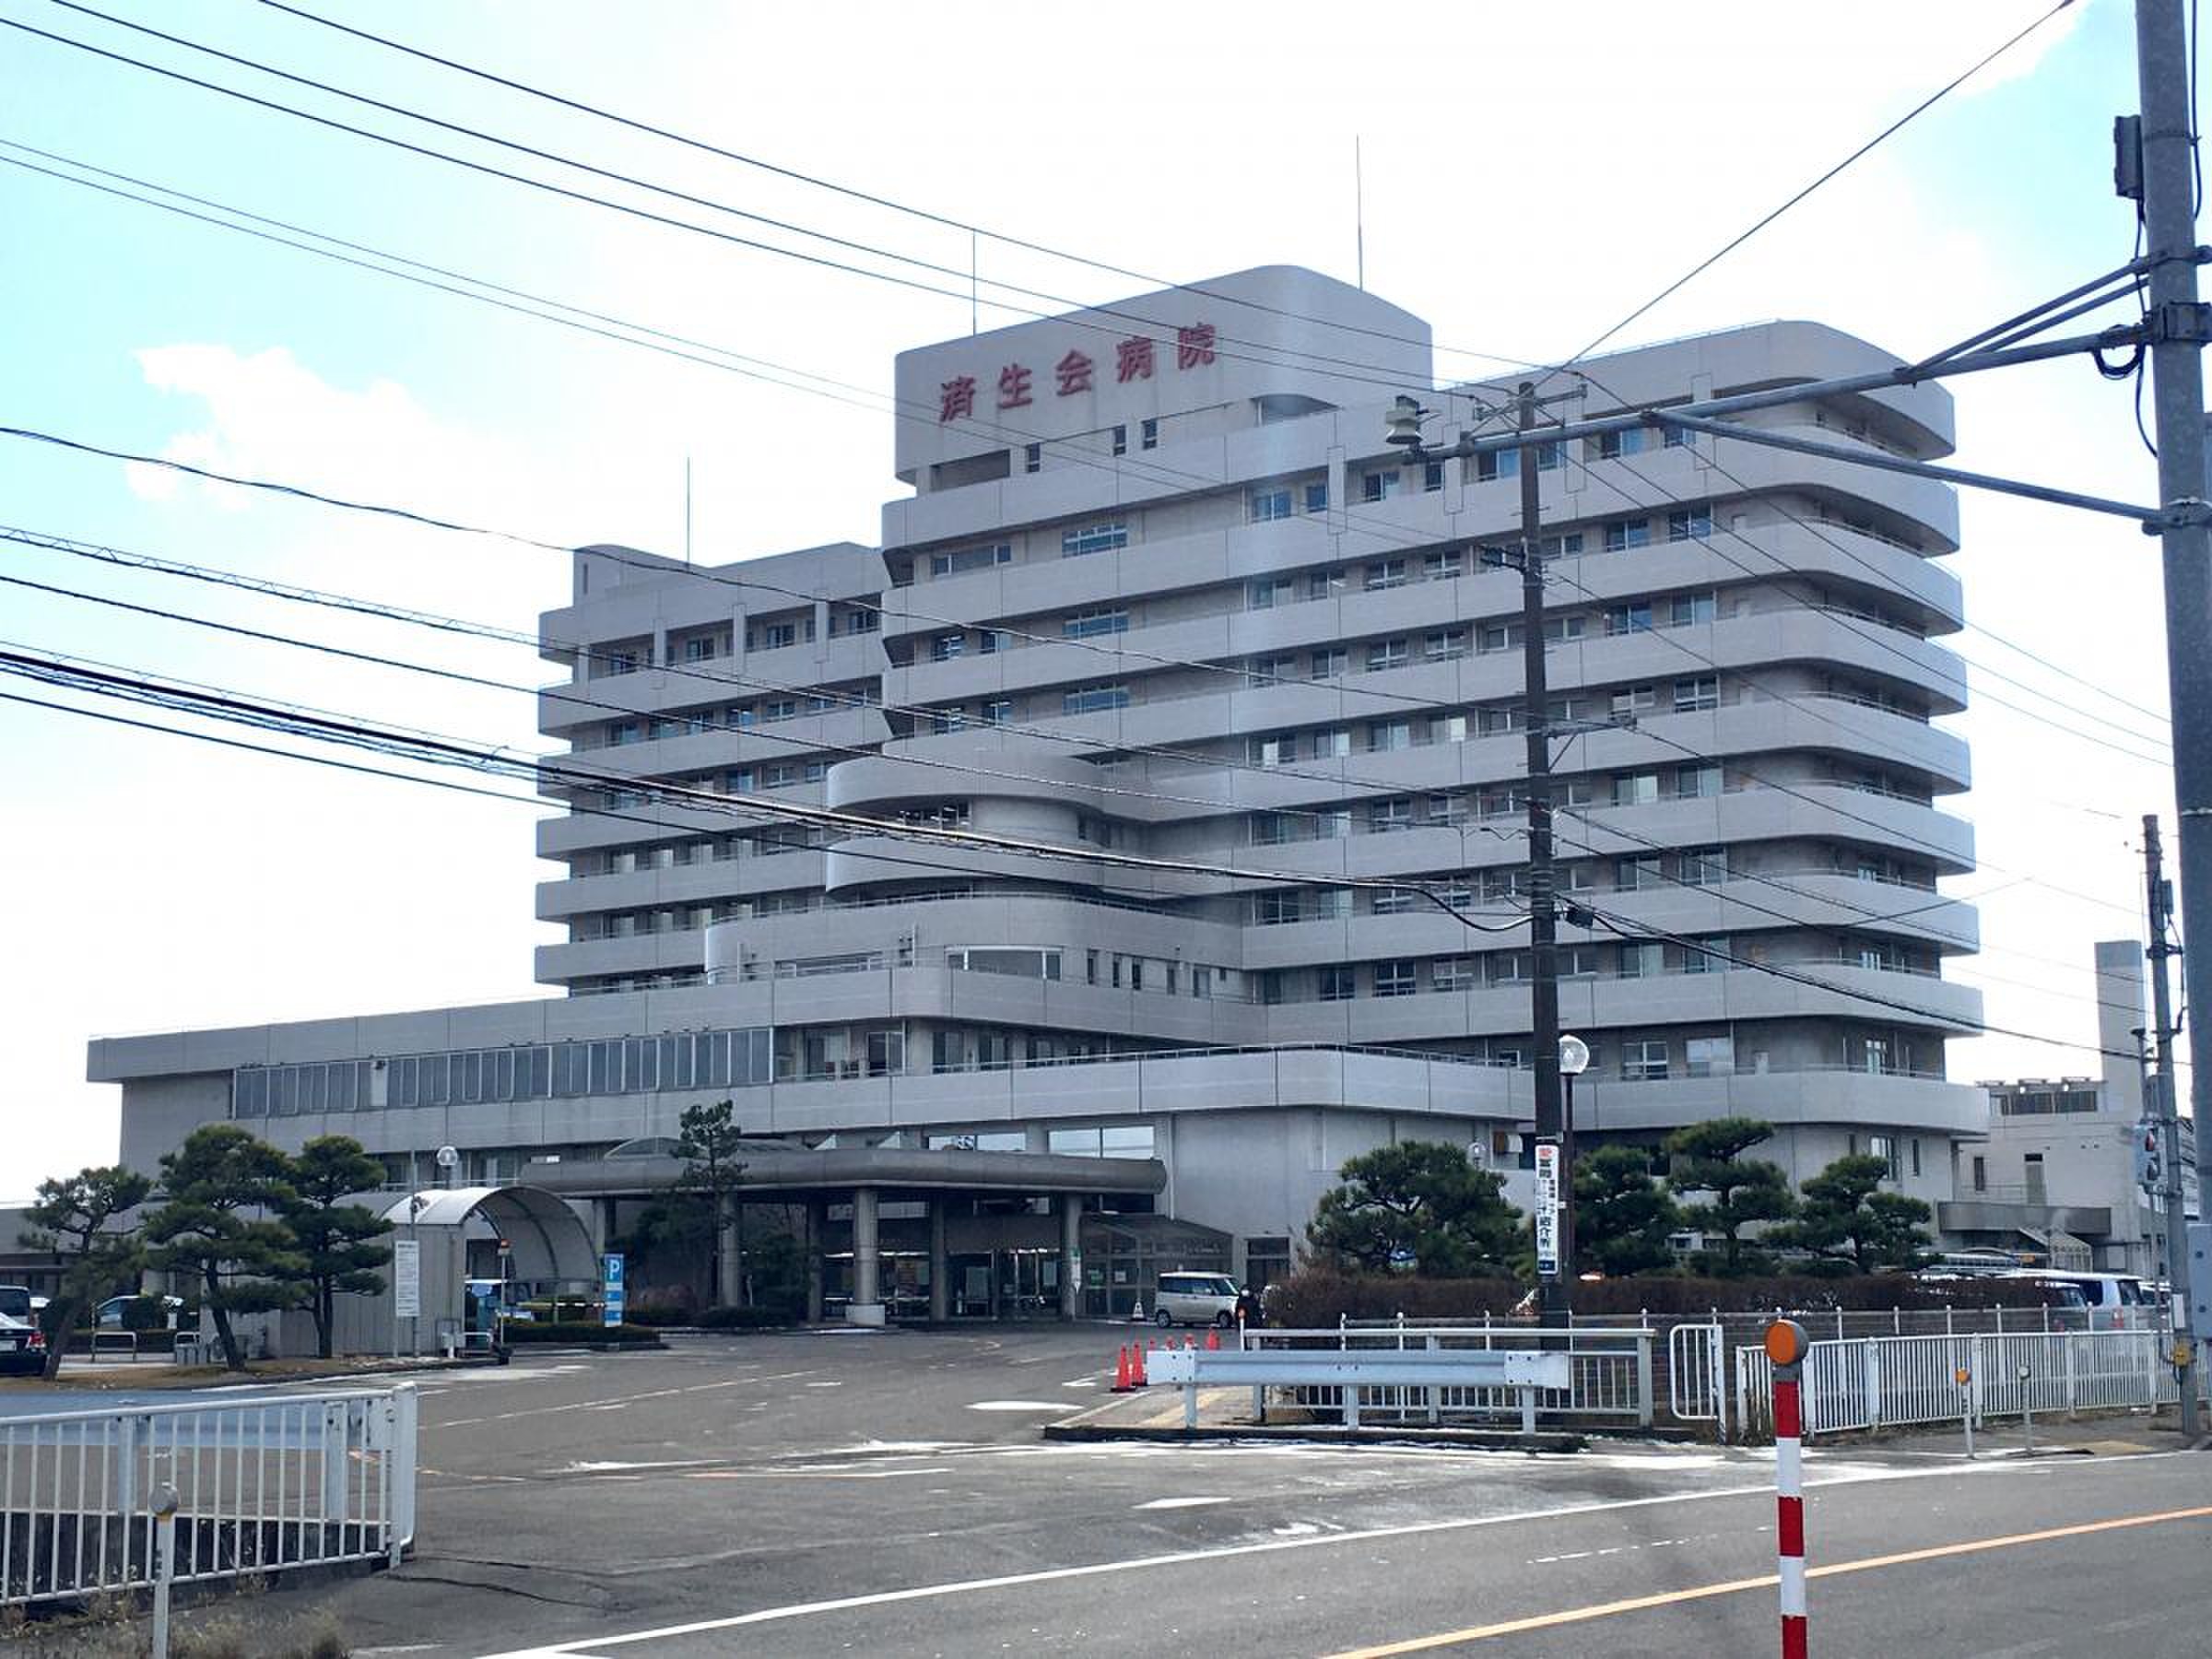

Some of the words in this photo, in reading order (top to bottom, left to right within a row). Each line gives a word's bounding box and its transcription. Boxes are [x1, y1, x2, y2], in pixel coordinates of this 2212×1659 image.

[939, 322, 1217, 423] 済生会病院
[609, 1259, 620, 1280] P
